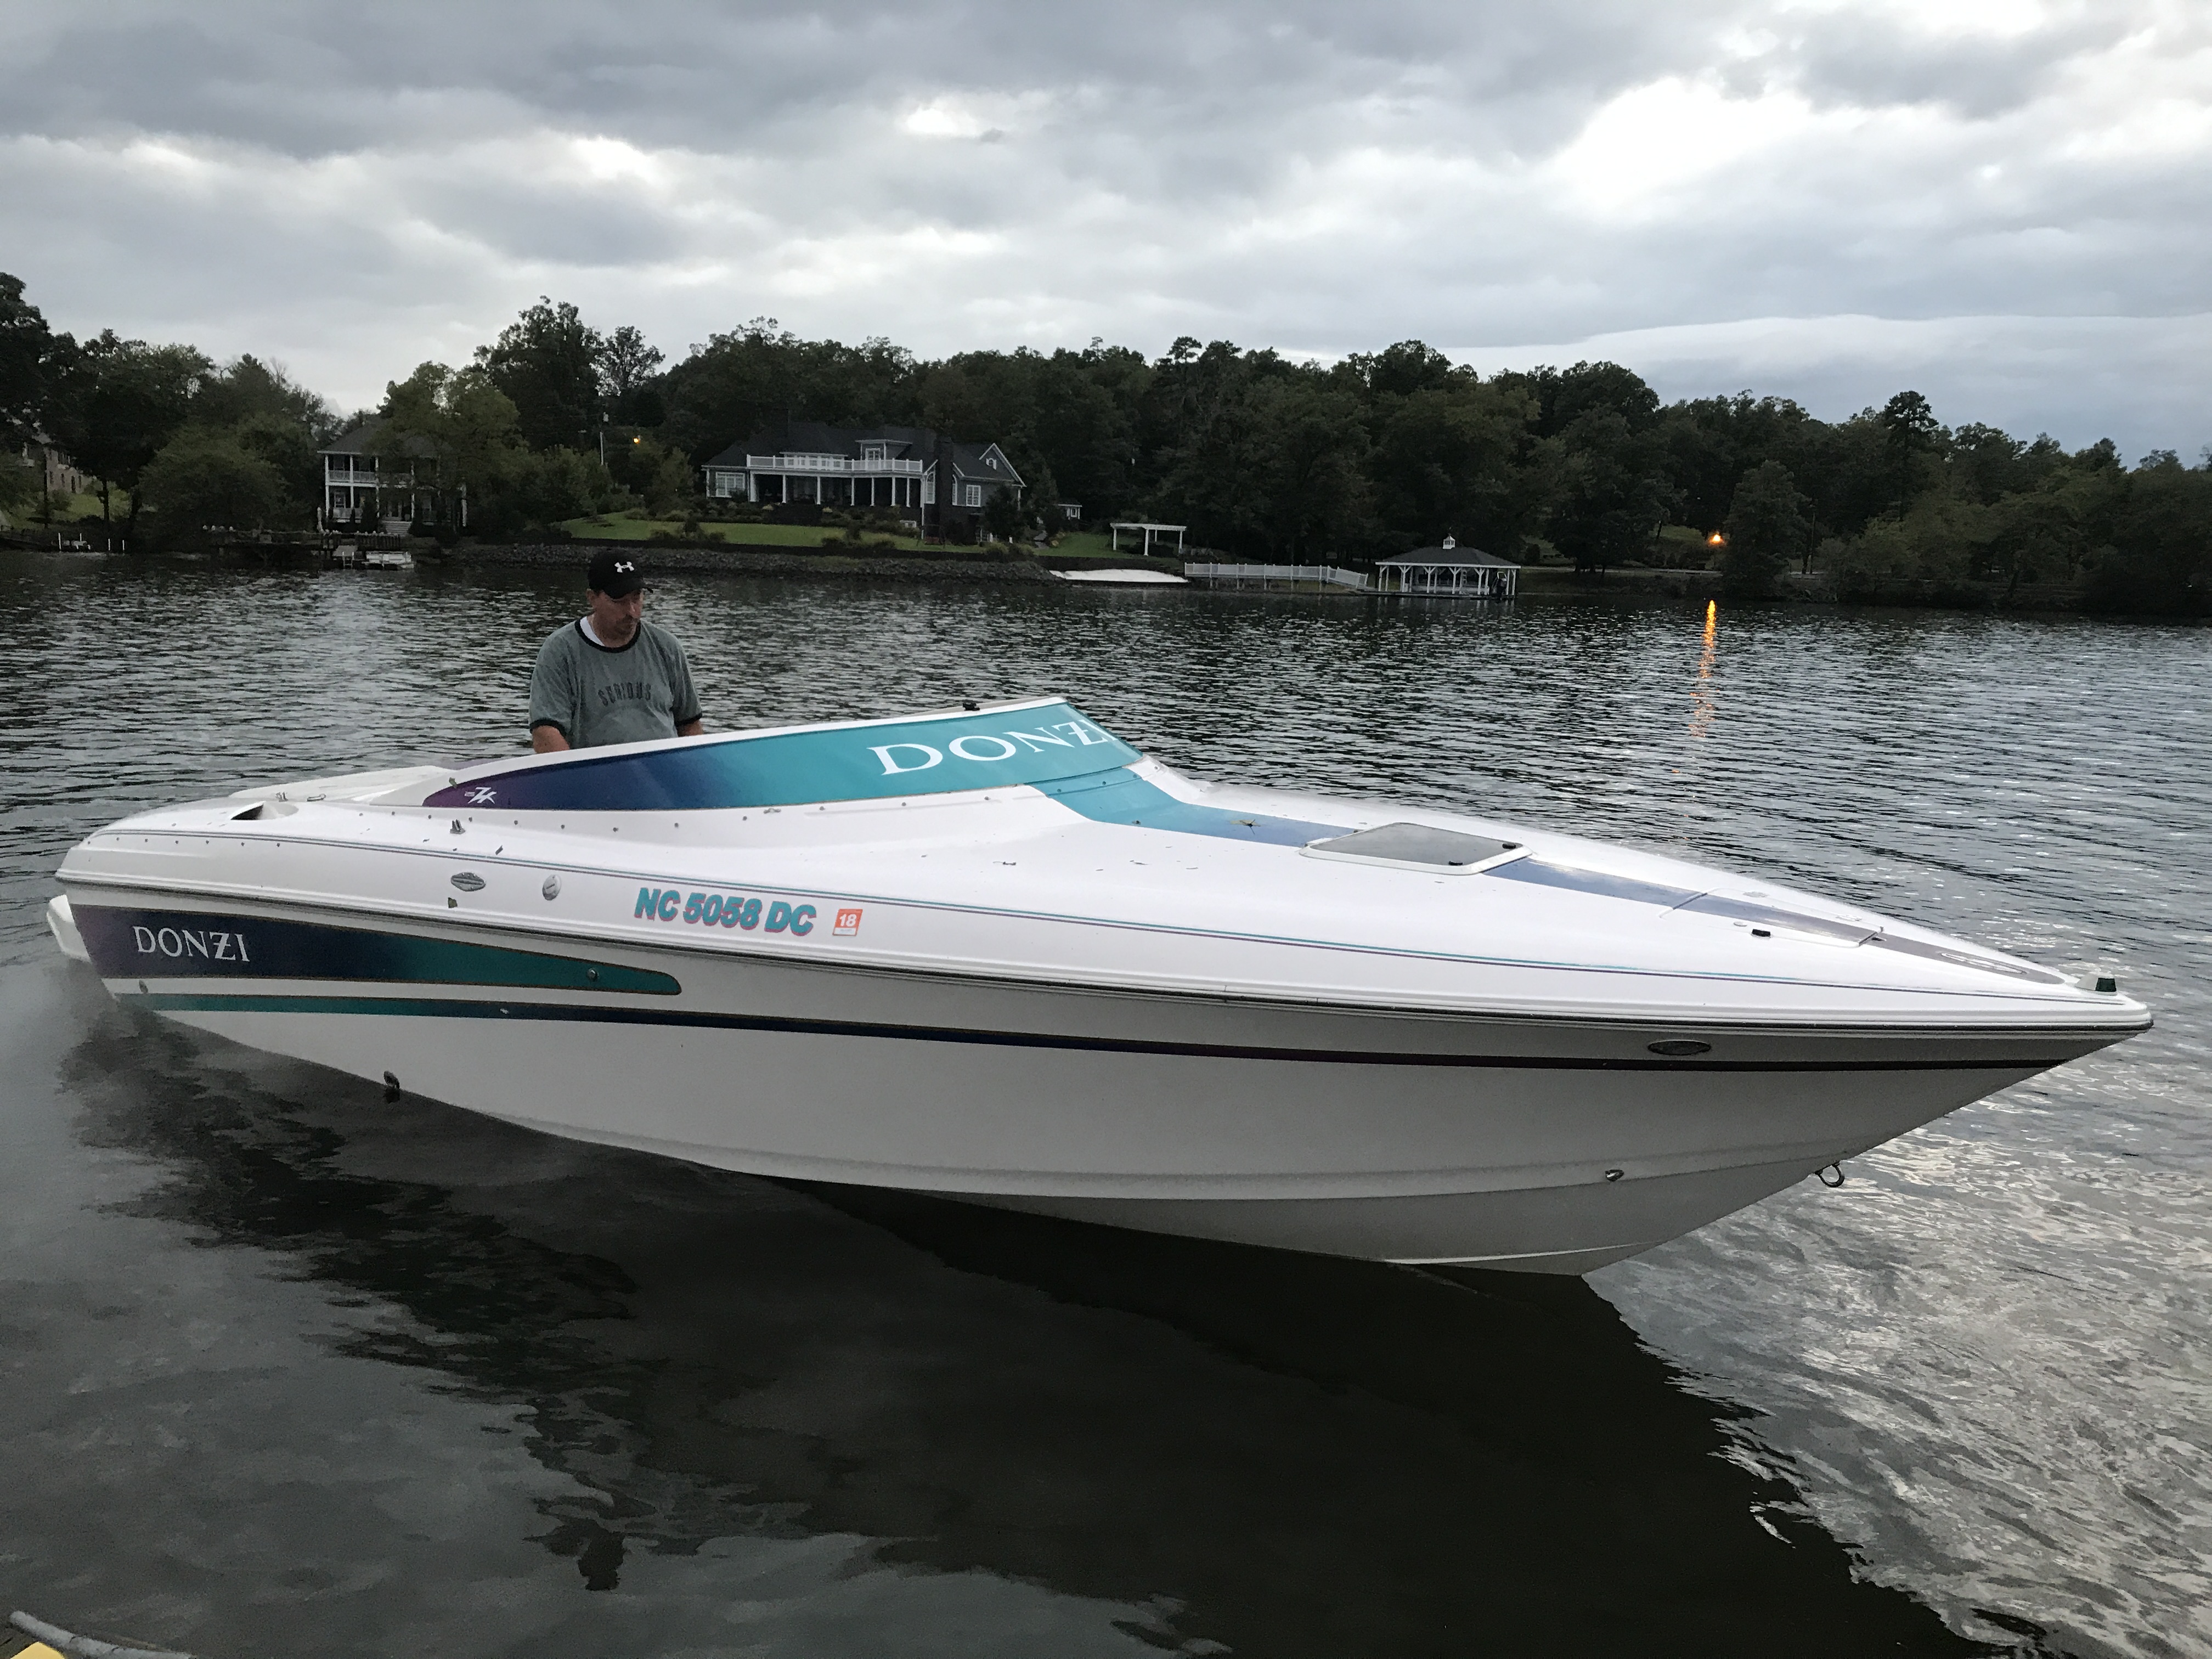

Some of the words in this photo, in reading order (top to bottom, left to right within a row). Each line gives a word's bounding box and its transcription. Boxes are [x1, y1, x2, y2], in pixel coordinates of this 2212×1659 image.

[867, 719, 1118, 776] DONZI
[634, 887, 681, 922] NC
[682, 892, 763, 930] 5058
[764, 901, 817, 936] DC
[839, 914, 857, 927] 18
[132, 926, 250, 962] DONZI
